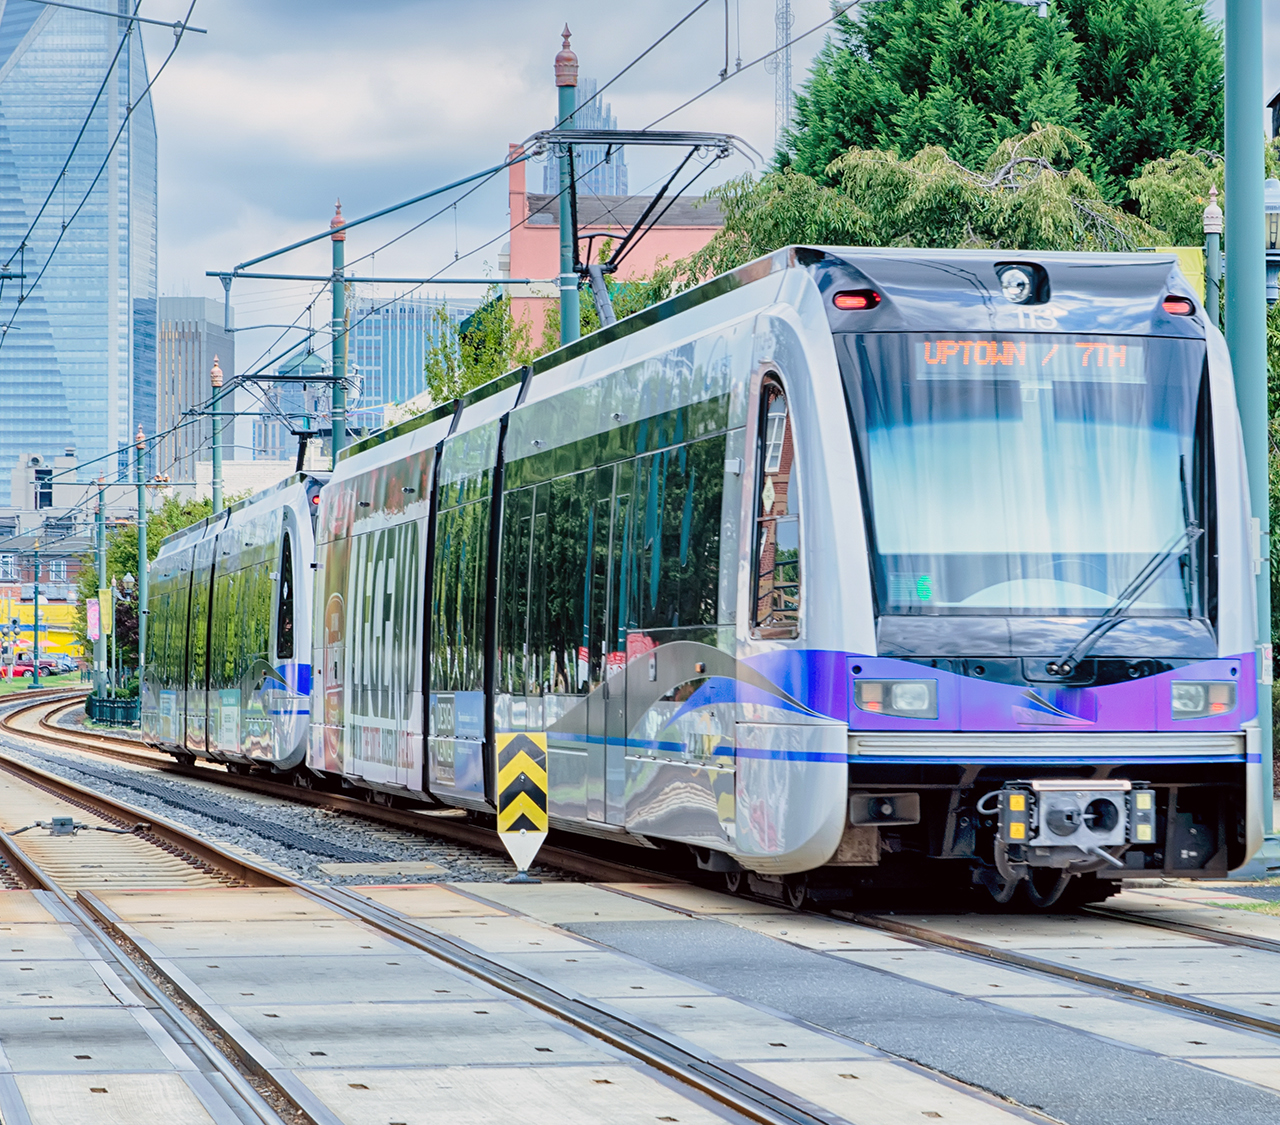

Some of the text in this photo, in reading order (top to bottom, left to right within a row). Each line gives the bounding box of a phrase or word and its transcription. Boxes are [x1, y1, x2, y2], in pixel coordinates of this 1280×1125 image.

[1016, 307, 1058, 330] 113
[924, 340, 1026, 366] UPTOWN
[1075, 342, 1127, 367] 7TH
[917, 575, 932, 601] 6
[350, 521, 419, 721] LEGEND
